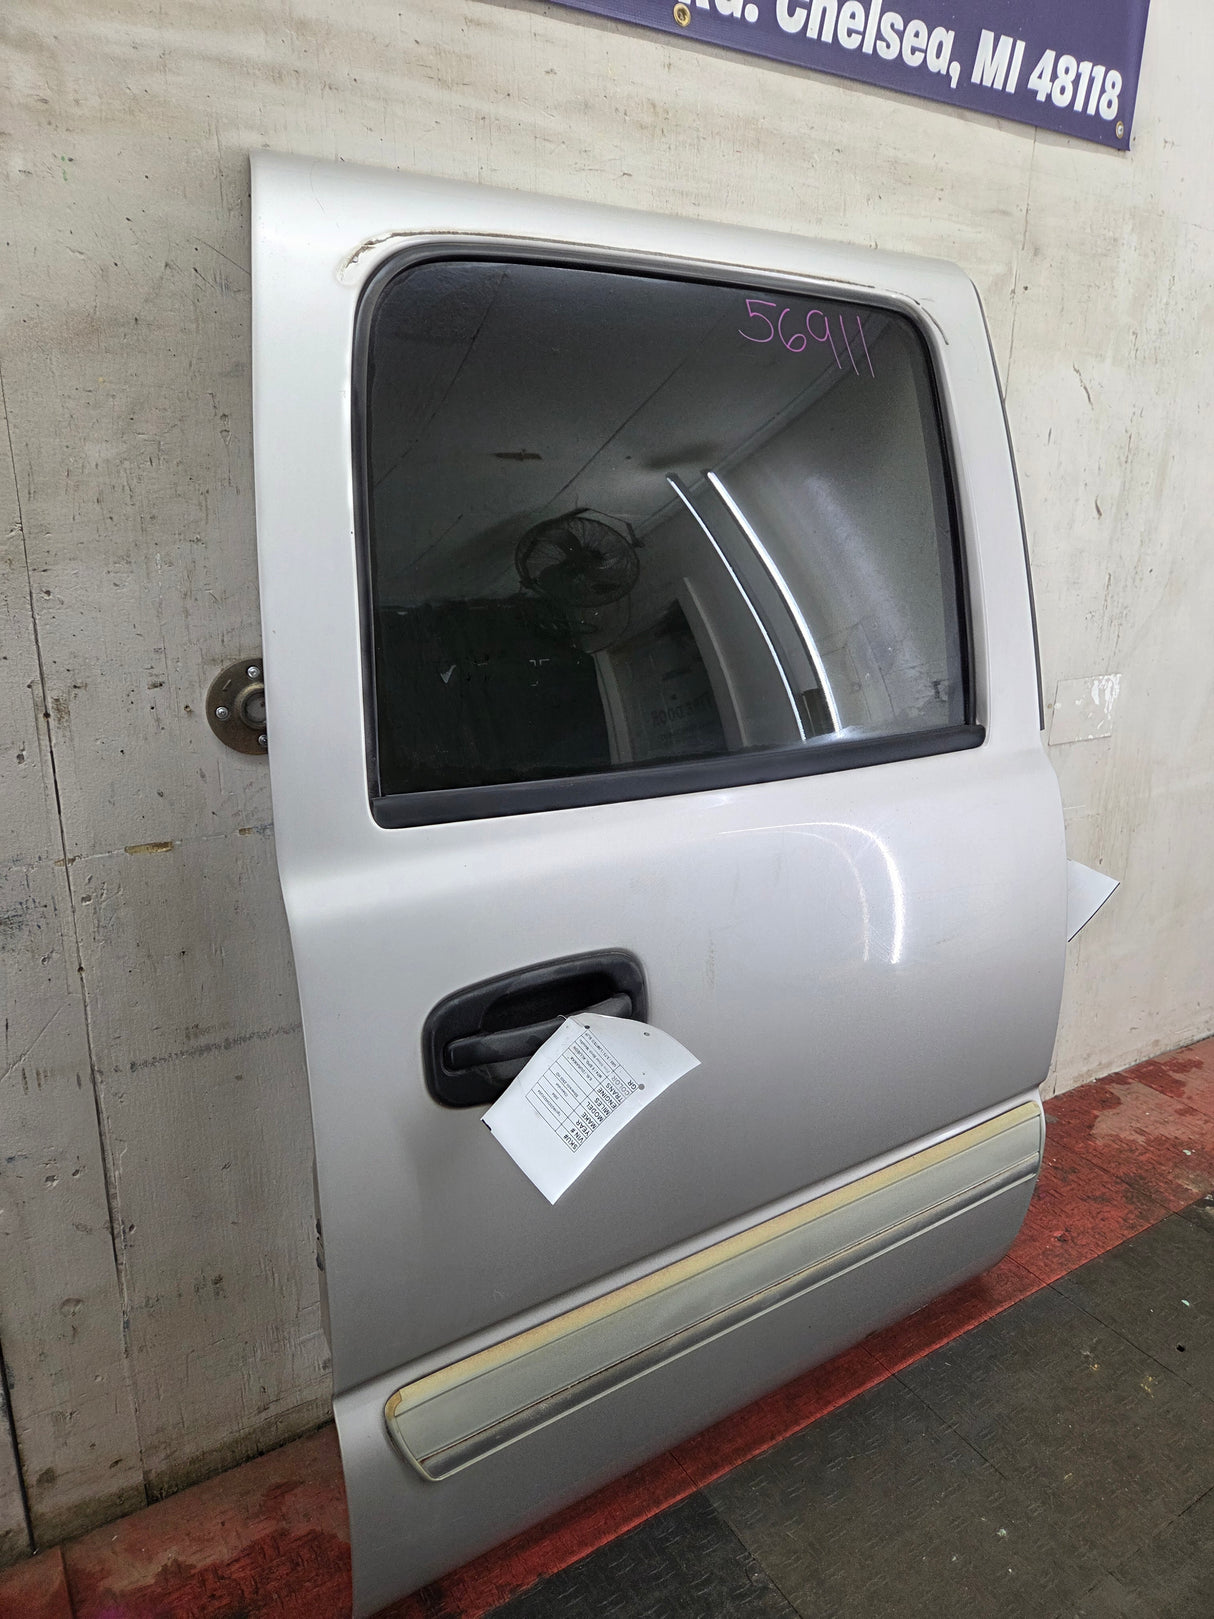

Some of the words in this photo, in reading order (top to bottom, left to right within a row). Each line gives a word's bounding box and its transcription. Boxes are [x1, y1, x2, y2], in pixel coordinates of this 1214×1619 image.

[775, 0, 961, 89] Chelsea,
[971, 28, 1026, 94] MI
[1027, 48, 1123, 121] 48118
[738, 298, 875, 378] 56911
[605, 1082, 623, 1103] TRANS
[610, 1075, 630, 1097] COLOR
[627, 1079, 637, 1090] GR
[593, 1097, 610, 1116] MILES
[596, 1086, 617, 1110] ENGINE
[580, 1111, 597, 1129] MAKE
[586, 1100, 604, 1122] MODEL
[573, 1131, 584, 1143] VIN
[575, 1119, 590, 1136] YEAR
[562, 1134, 578, 1150] SKU#
